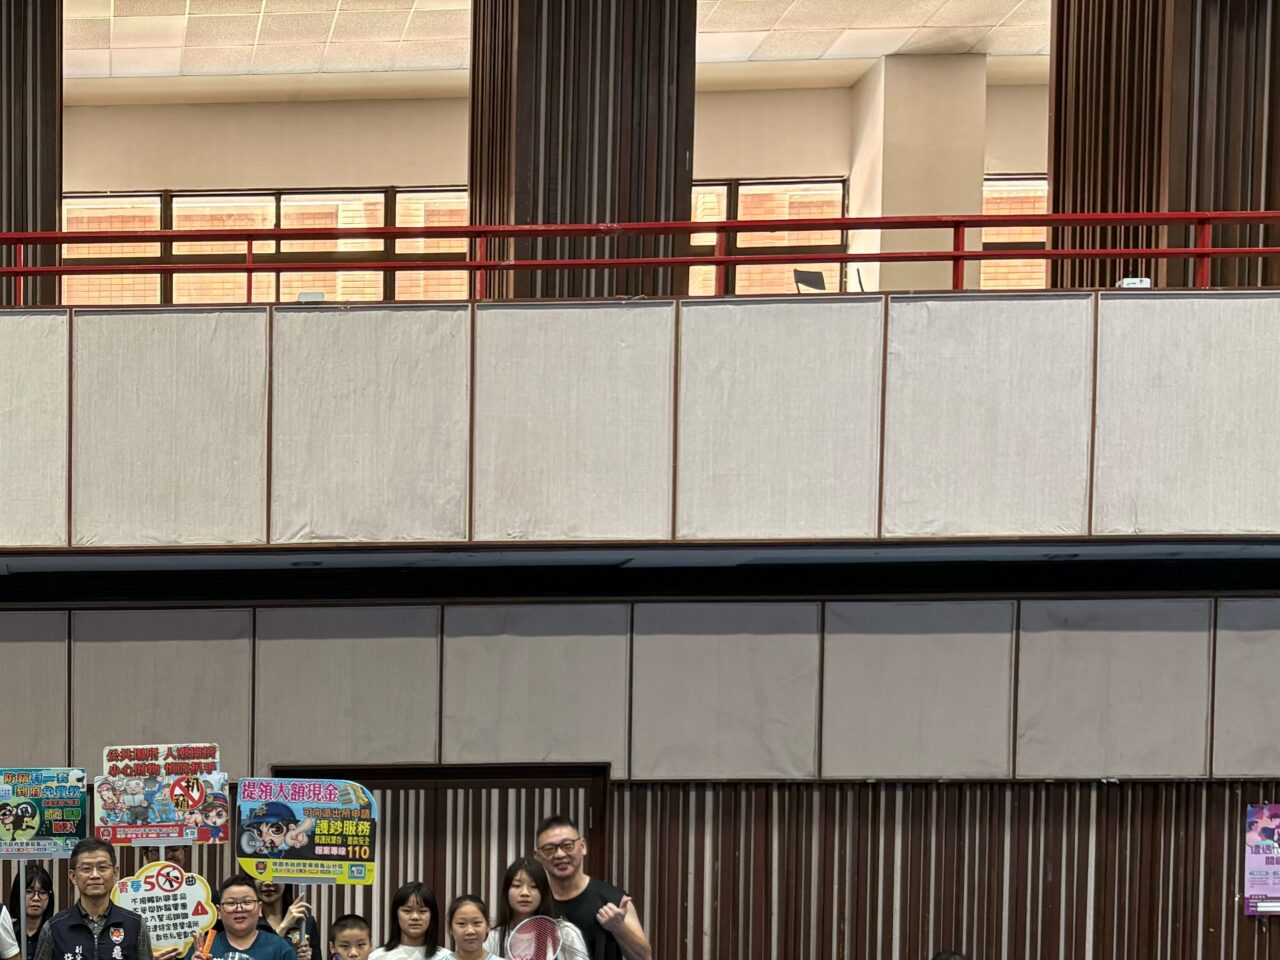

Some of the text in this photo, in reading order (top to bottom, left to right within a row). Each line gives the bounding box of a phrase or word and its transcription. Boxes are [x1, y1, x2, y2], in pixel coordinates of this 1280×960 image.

[242, 781, 340, 802] 提領大額現金
[315, 820, 371, 836] 護鈔服務
[348, 846, 369, 859] 110
